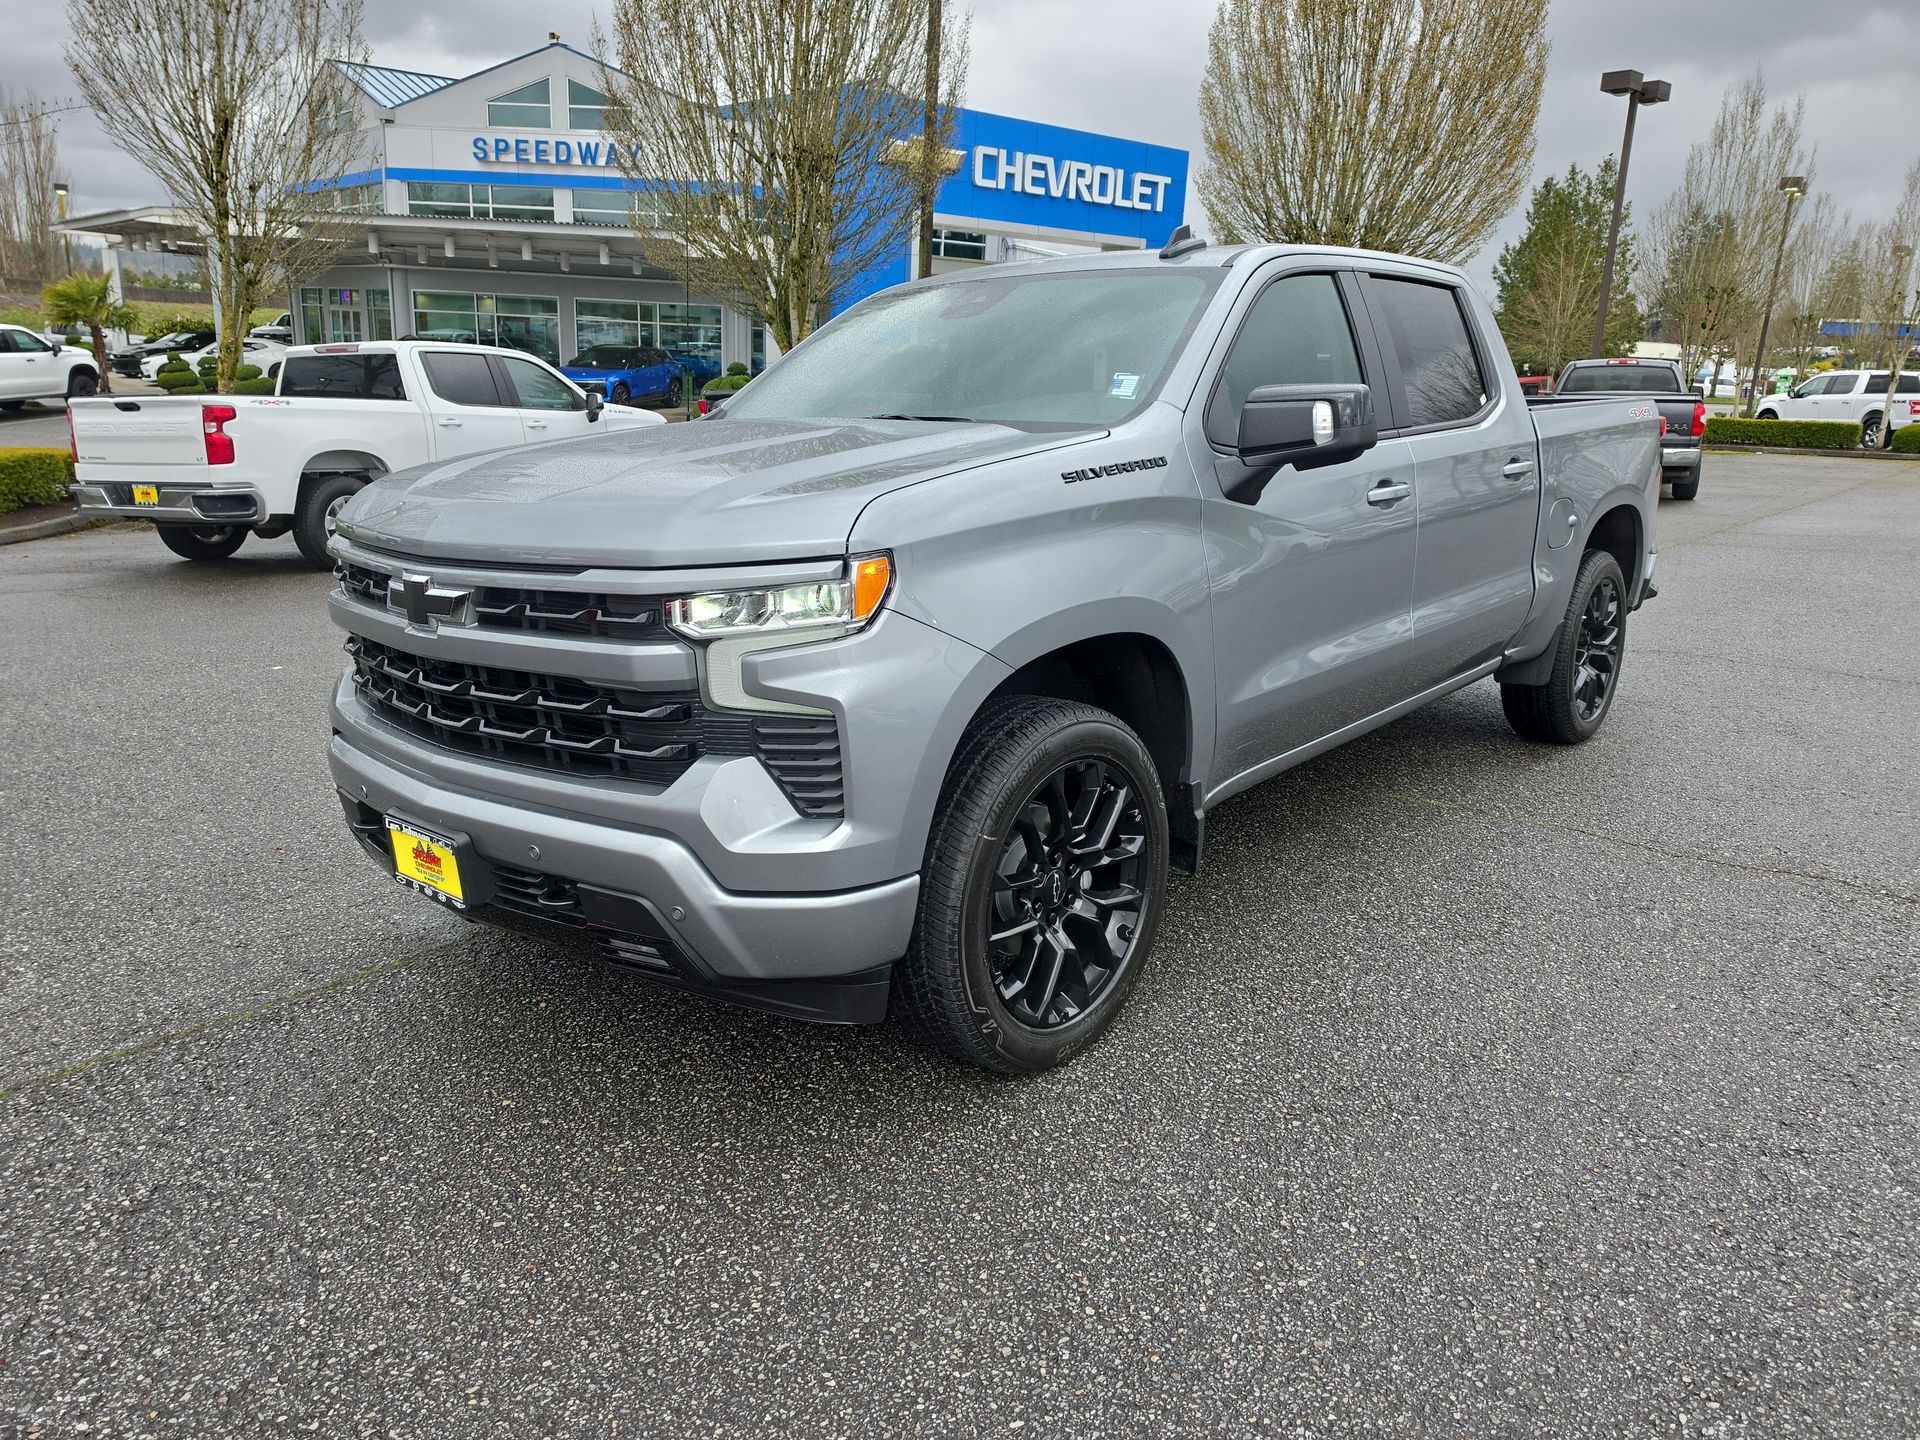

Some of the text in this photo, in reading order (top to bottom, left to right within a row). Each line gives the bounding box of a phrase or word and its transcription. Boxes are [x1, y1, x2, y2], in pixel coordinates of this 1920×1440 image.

[973, 145, 1172, 212] CHEVROLET
[78, 422, 190, 434] CHEVROLET
[1061, 456, 1168, 484] SILVERADO
[988, 744, 1050, 828] BRIDGESTONE
